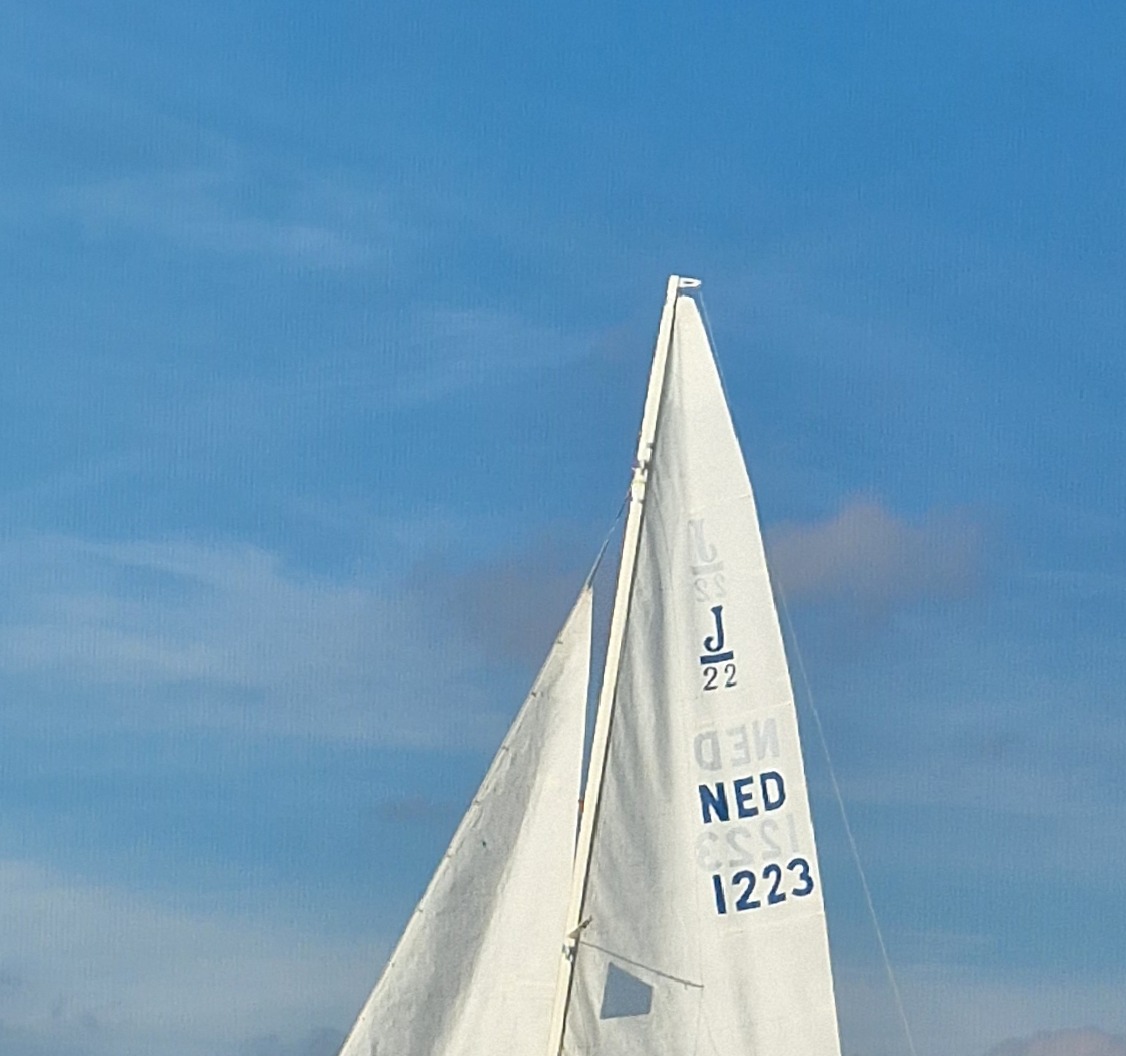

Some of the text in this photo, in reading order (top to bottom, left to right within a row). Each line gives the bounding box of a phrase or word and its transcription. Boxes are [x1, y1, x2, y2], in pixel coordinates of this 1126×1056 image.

[703, 605, 724, 652] J
[703, 663, 738, 692] 22
[698, 770, 787, 824] NED
[712, 857, 815, 915] 1223
